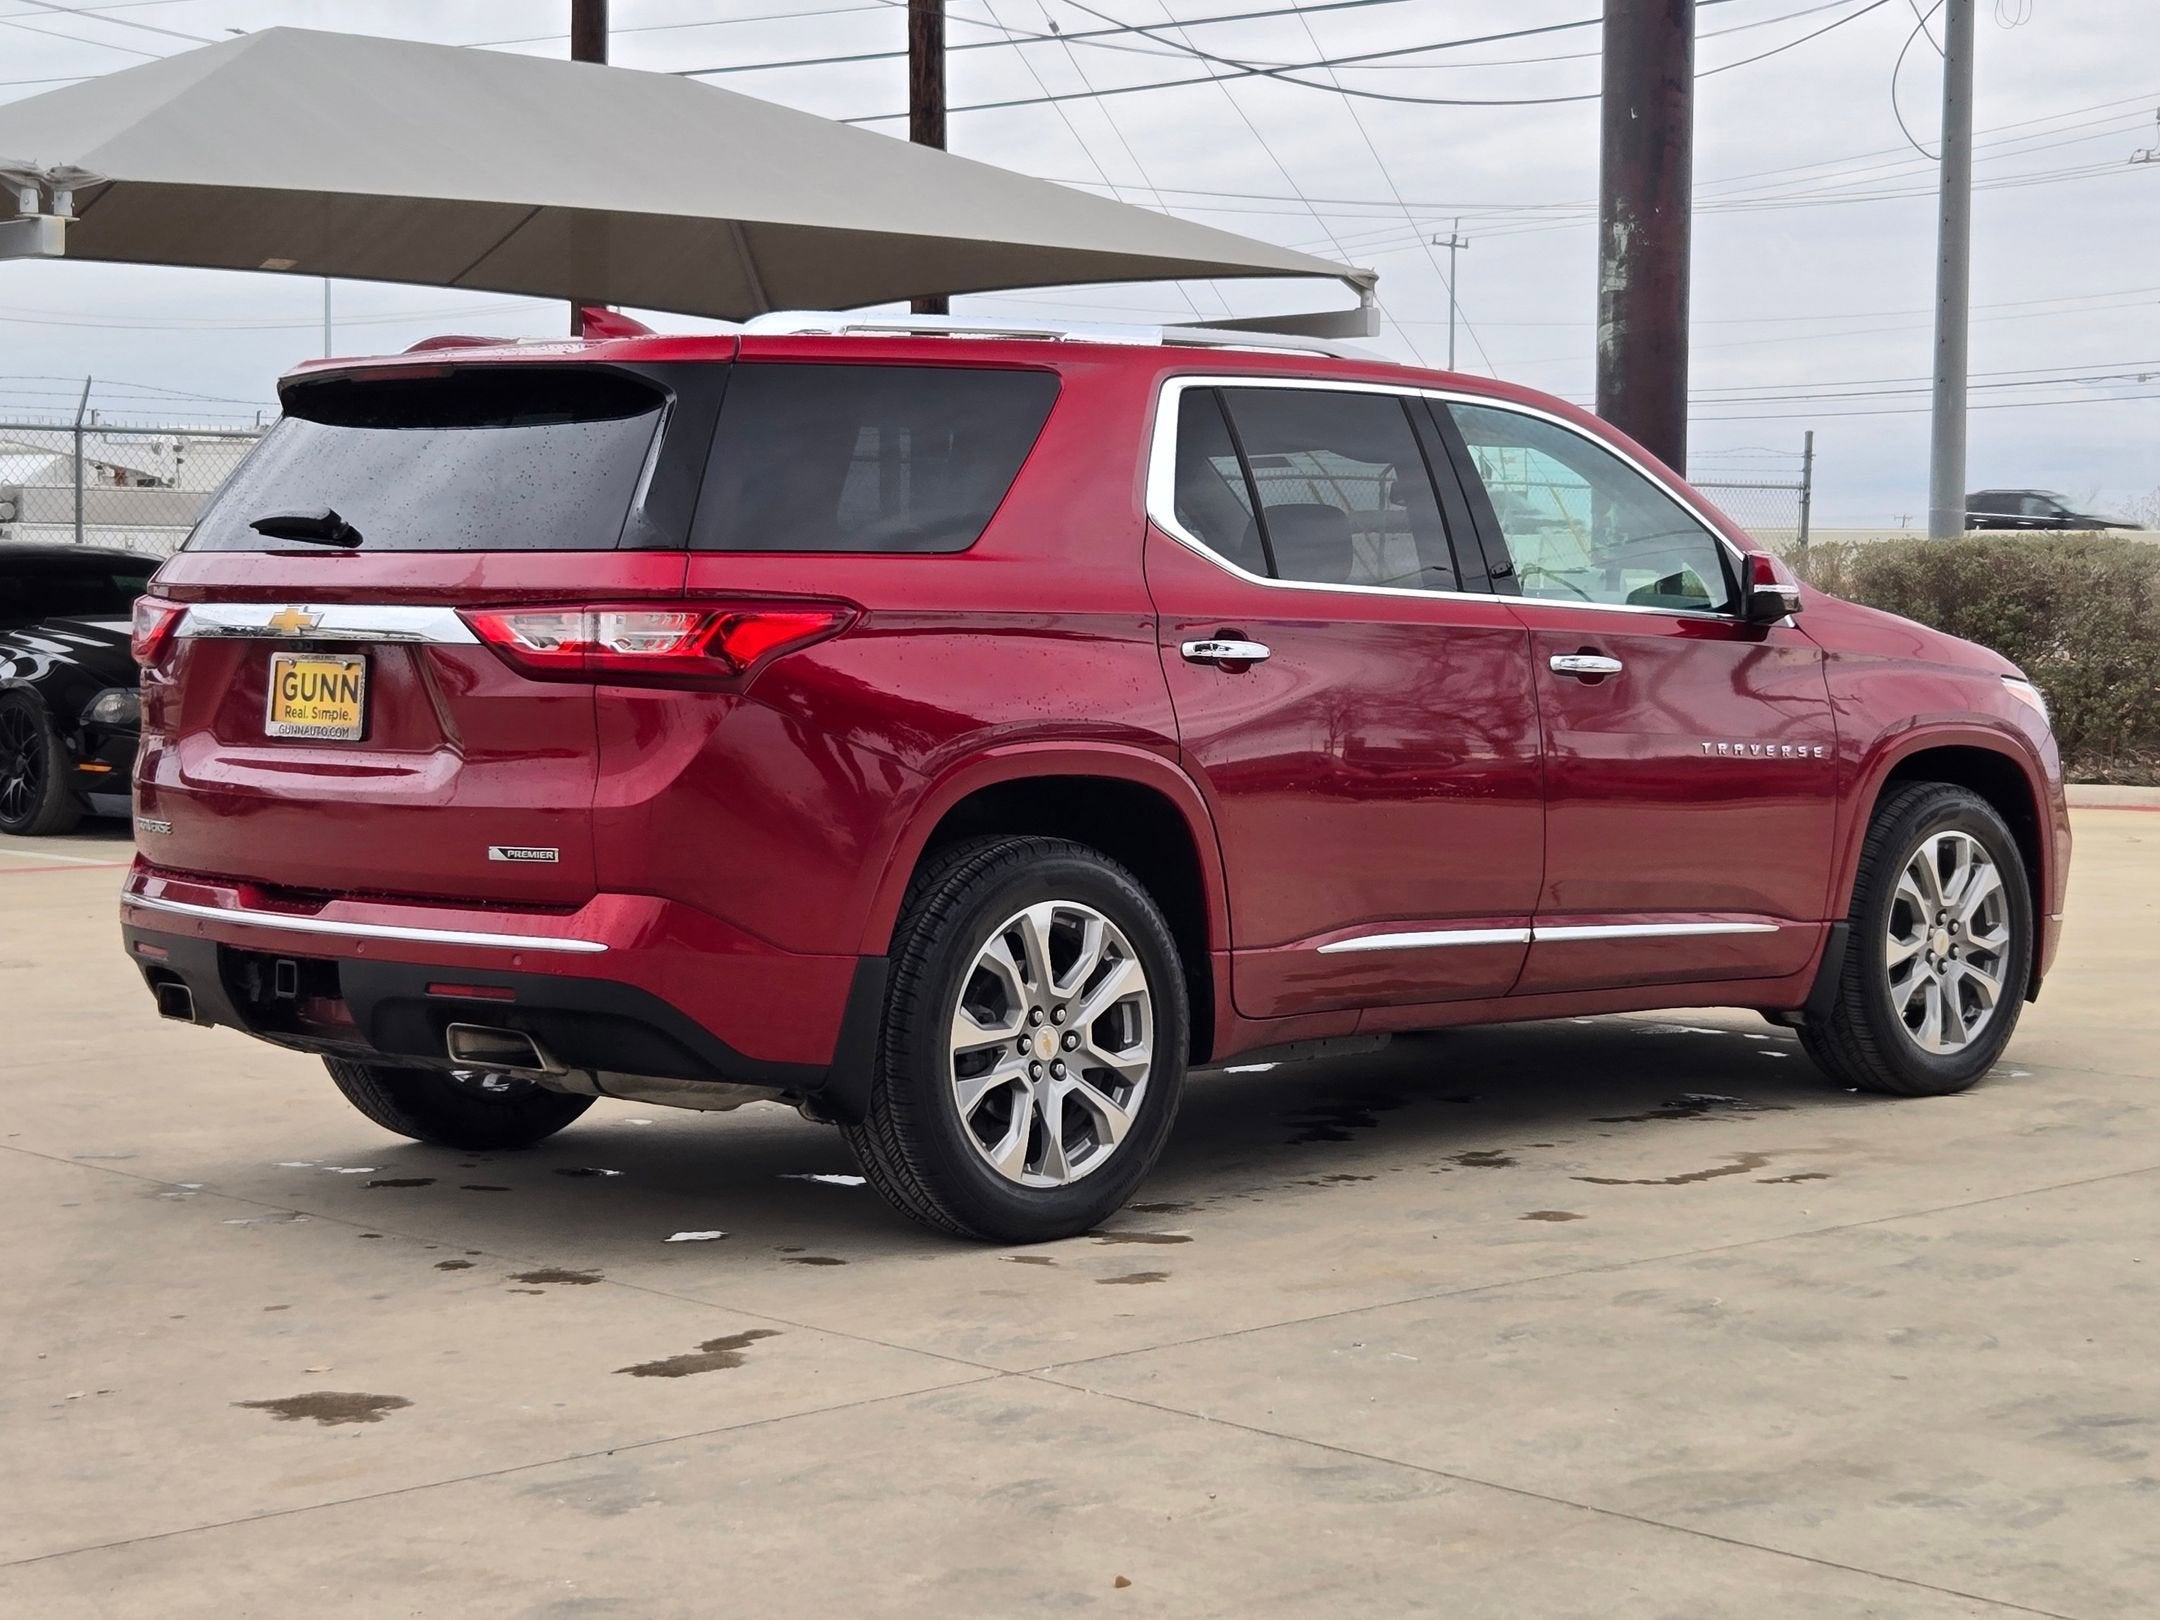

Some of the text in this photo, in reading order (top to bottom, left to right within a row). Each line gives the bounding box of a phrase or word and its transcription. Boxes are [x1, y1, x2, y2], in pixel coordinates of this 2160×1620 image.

[282, 671, 360, 704] GUNN
[285, 705, 353, 722] Real. Simple.
[278, 724, 350, 738] GUNNAUTO.COM
[1701, 742, 1824, 759] TRAVERSE
[507, 850, 554, 860] PREMIER
